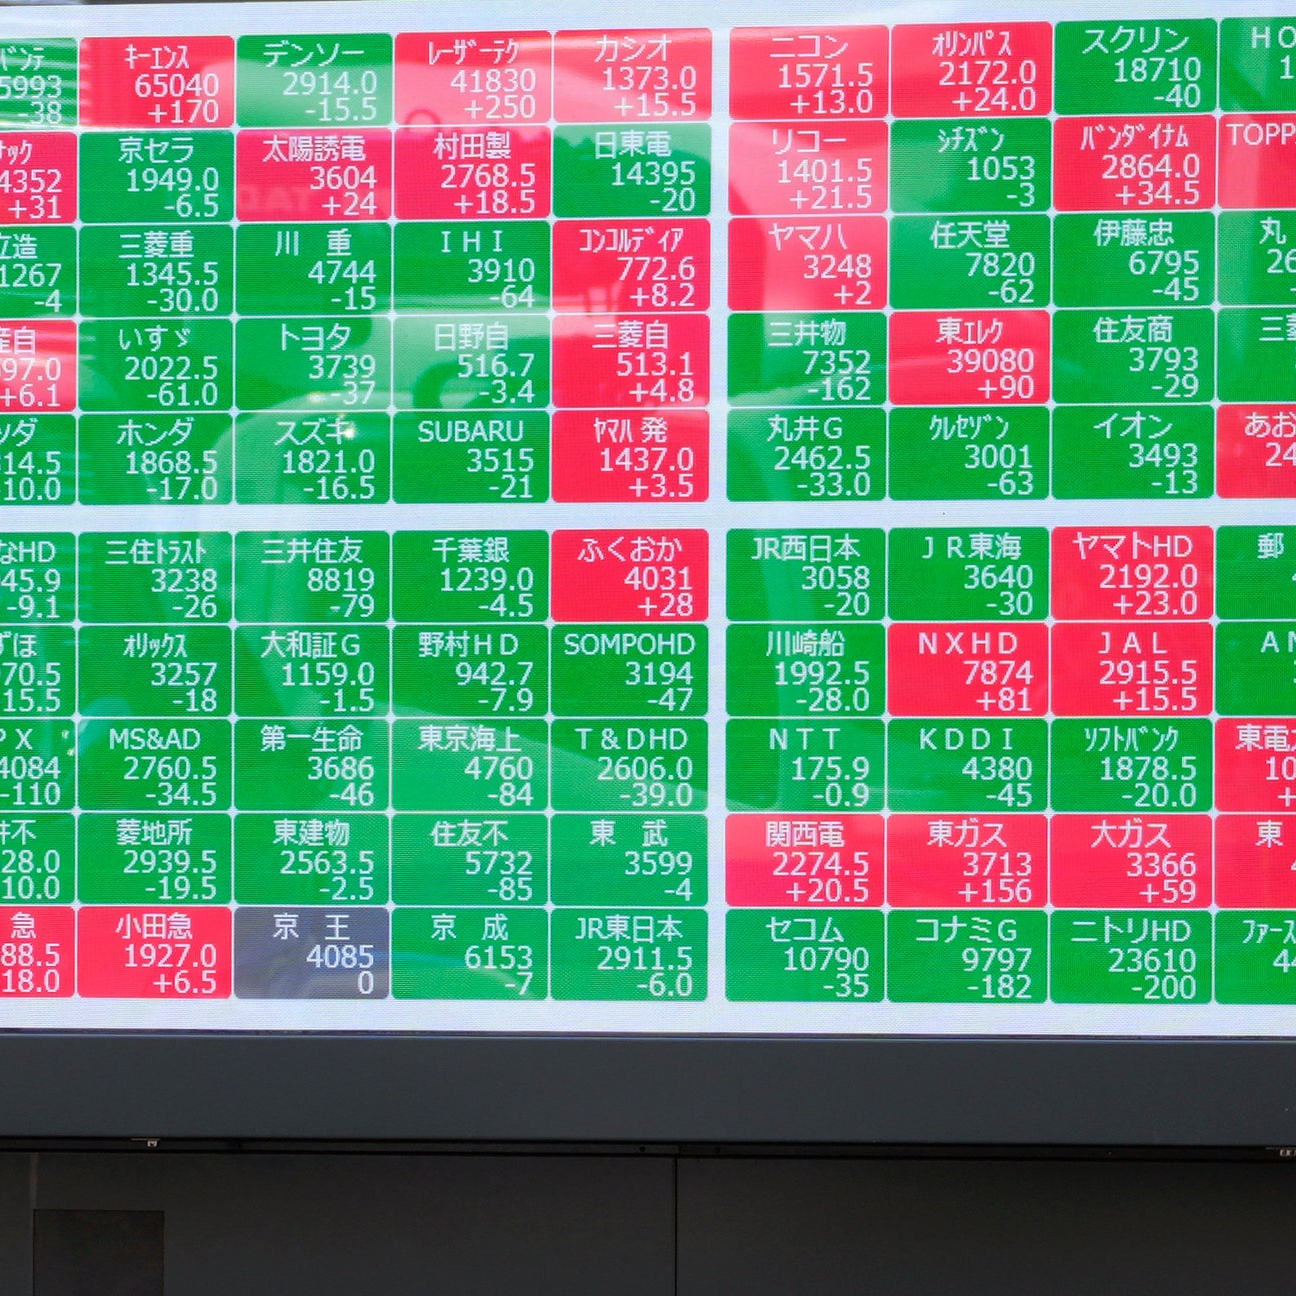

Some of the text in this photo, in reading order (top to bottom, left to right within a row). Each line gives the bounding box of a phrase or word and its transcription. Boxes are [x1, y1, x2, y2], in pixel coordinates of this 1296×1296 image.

[1082, 24, 1189, 55] スクリン
[1114, 56, 1202, 83] 18710
[1153, 82, 1202, 110] -40
[118, 135, 195, 165] 京セラ
[262, 134, 367, 163] 太陽誘電
[126, 166, 220, 193] 1949.0
[309, 164, 378, 191] 3604
[164, 191, 220, 219] -6.5
[321, 190, 378, 217] +24
[118, 229, 195, 260] 三菱重
[929, 219, 1011, 250] 任天堂
[126, 260, 219, 287] 1345.5
[965, 251, 1036, 278] 7820
[146, 286, 219, 313] -30.0
[988, 277, 1035, 304] -62
[1092, 313, 1174, 344] 住友商
[1128, 345, 1199, 373] 3793
[1151, 371, 1200, 398] -29
[417, 419, 524, 443] SUBARU
[766, 413, 843, 443] 丸井G
[466, 447, 535, 473] 3515
[773, 444, 871, 472] 2462.5
[488, 473, 534, 499] -21
[797, 471, 871, 496] -33.0
[260, 535, 364, 565] 三井住友
[1072, 530, 1194, 561] ヤマトHD
[306, 567, 375, 593] 8819
[1099, 563, 1199, 590] 2192.0
[329, 593, 375, 618] -79
[1112, 589, 1198, 616] +23.0
[563, 632, 696, 656] SOMPOHD
[625, 660, 694, 686] 3194
[647, 686, 694, 712] -47
[261, 723, 364, 753] 第一生命
[919, 727, 1013, 751] KDDI
[307, 755, 376, 782] 3686
[961, 755, 1033, 782] 4380
[328, 780, 375, 808] -46
[985, 781, 1033, 809] -45
[116, 817, 193, 846] 菱地所
[926, 816, 1008, 848] 東ガス
[122, 848, 218, 875] 2939.5
[962, 851, 1033, 877] 3713
[145, 874, 218, 901] -19.5
[957, 877, 1033, 904] +156
[115, 911, 194, 940] 小田急
[574, 913, 684, 944] JR東日本
[765, 916, 845, 944] セコム
[124, 942, 218, 969] 1927.0
[596, 945, 693, 972] 2911.5
[784, 946, 870, 972] 10790
[152, 968, 217, 994] +6.5
[636, 970, 694, 996] -6.0
[823, 972, 870, 999] -35
